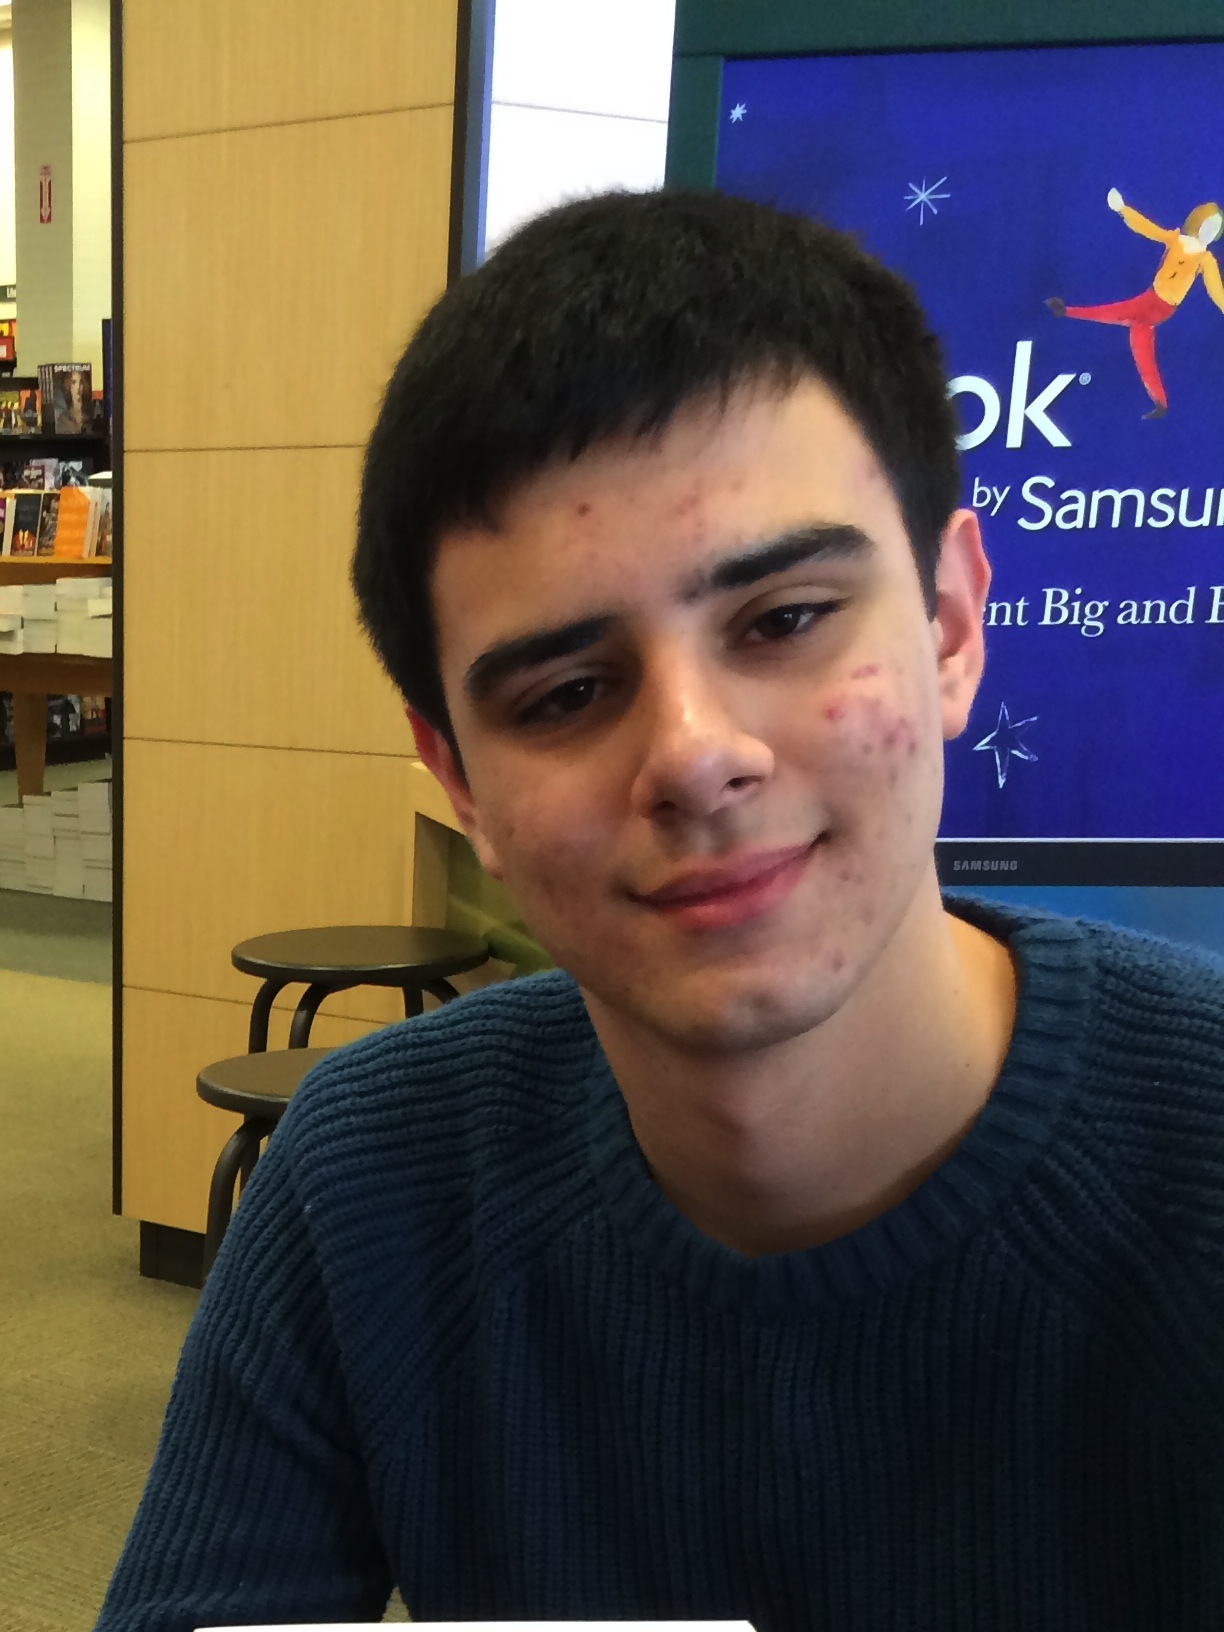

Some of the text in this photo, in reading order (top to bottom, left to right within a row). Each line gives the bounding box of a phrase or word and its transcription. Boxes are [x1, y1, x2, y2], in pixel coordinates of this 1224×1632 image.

[972, 475, 1224, 531] by Samsu
[1038, 585, 1110, 638] Big
[1117, 584, 1198, 625] and
[953, 860, 1018, 871] SAMSUNG
